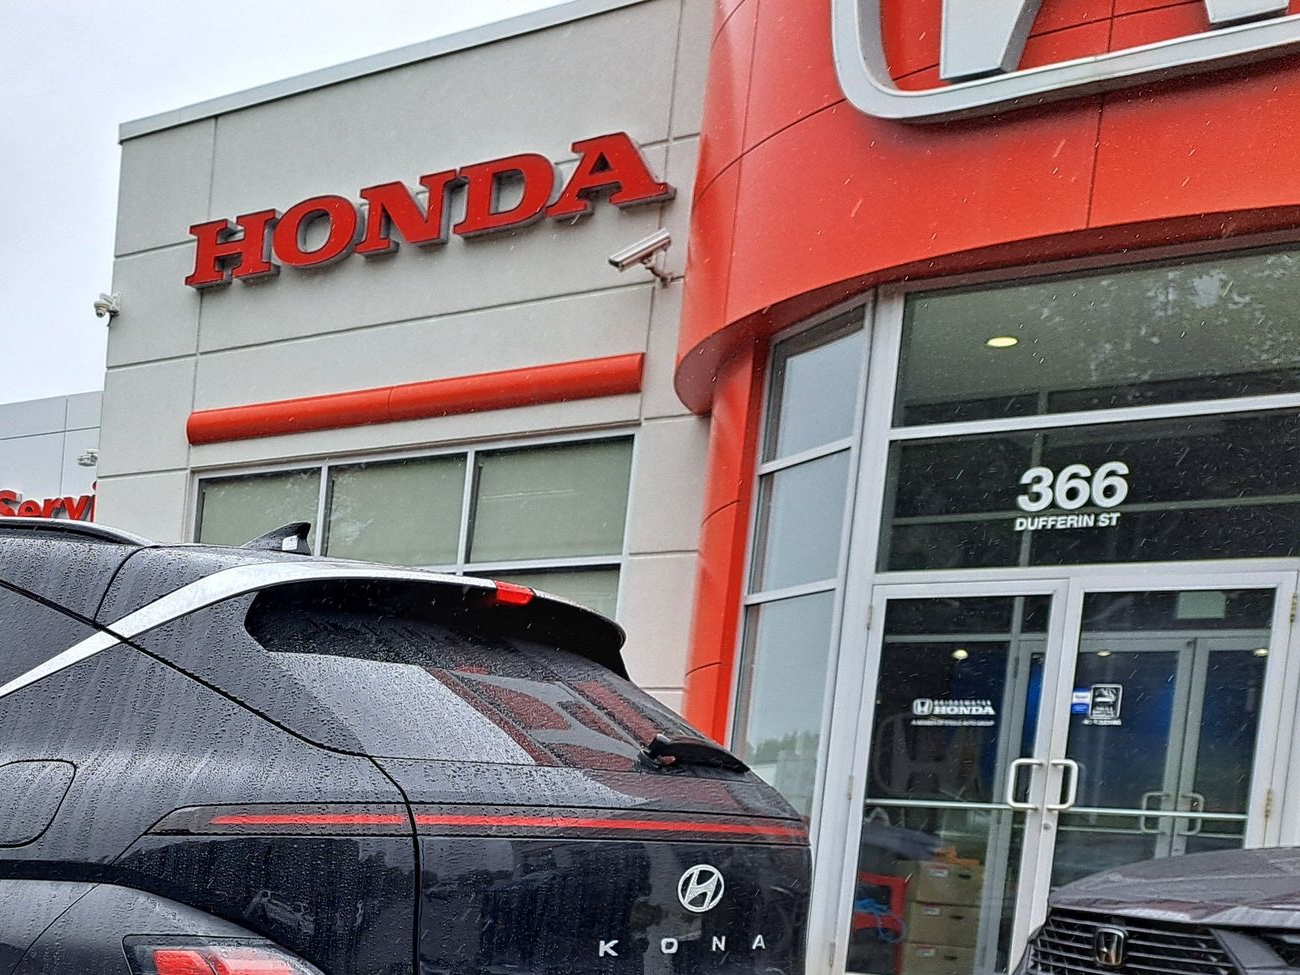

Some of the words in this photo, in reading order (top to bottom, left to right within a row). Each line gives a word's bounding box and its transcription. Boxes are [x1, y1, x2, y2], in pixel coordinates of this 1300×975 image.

[185, 131, 675, 289] HONDA
[1017, 461, 1129, 512] 366
[1014, 514, 1095, 531] DUFFERIN
[1097, 512, 1121, 527] ST
[932, 706, 996, 715] HONDA
[598, 934, 767, 957] KONA
